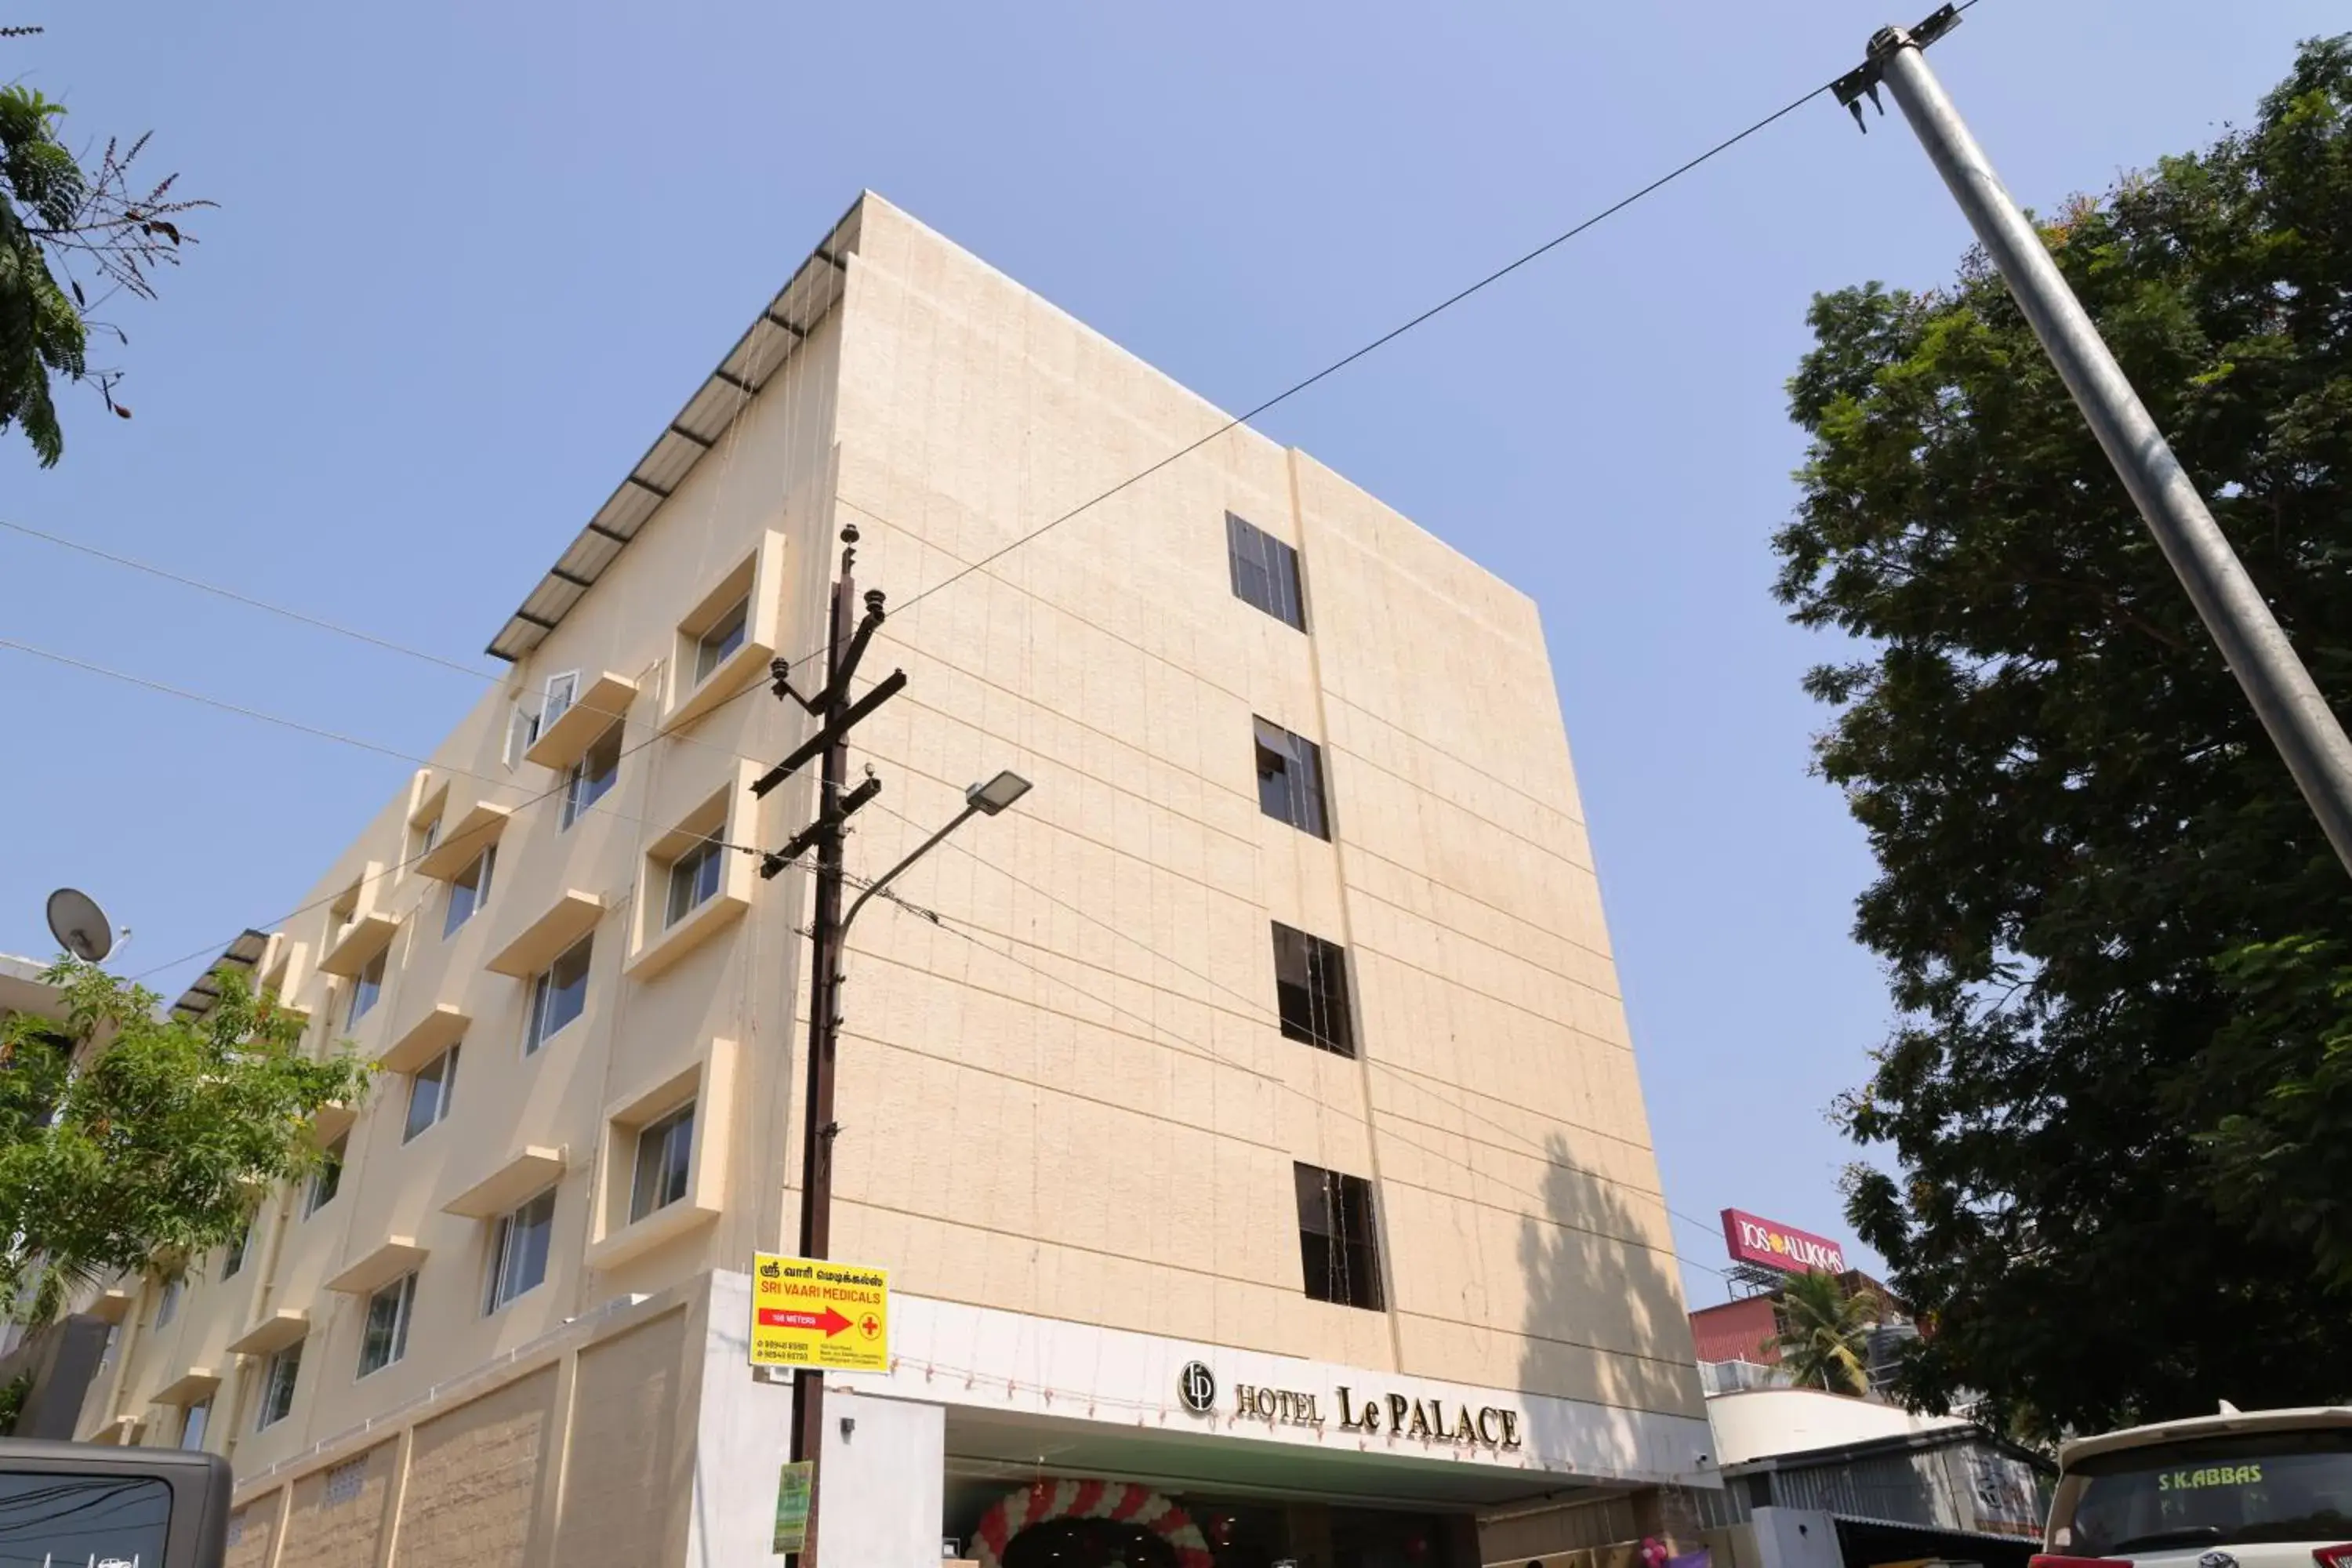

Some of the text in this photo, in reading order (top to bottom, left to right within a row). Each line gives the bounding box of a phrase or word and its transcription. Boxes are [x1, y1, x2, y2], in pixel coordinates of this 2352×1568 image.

[784, 1266, 813, 1279] வாரி
[761, 1280, 880, 1305] SRI VAARI MEDICALS
[1236, 1385, 1523, 1447] HOTEL Le PALACE
